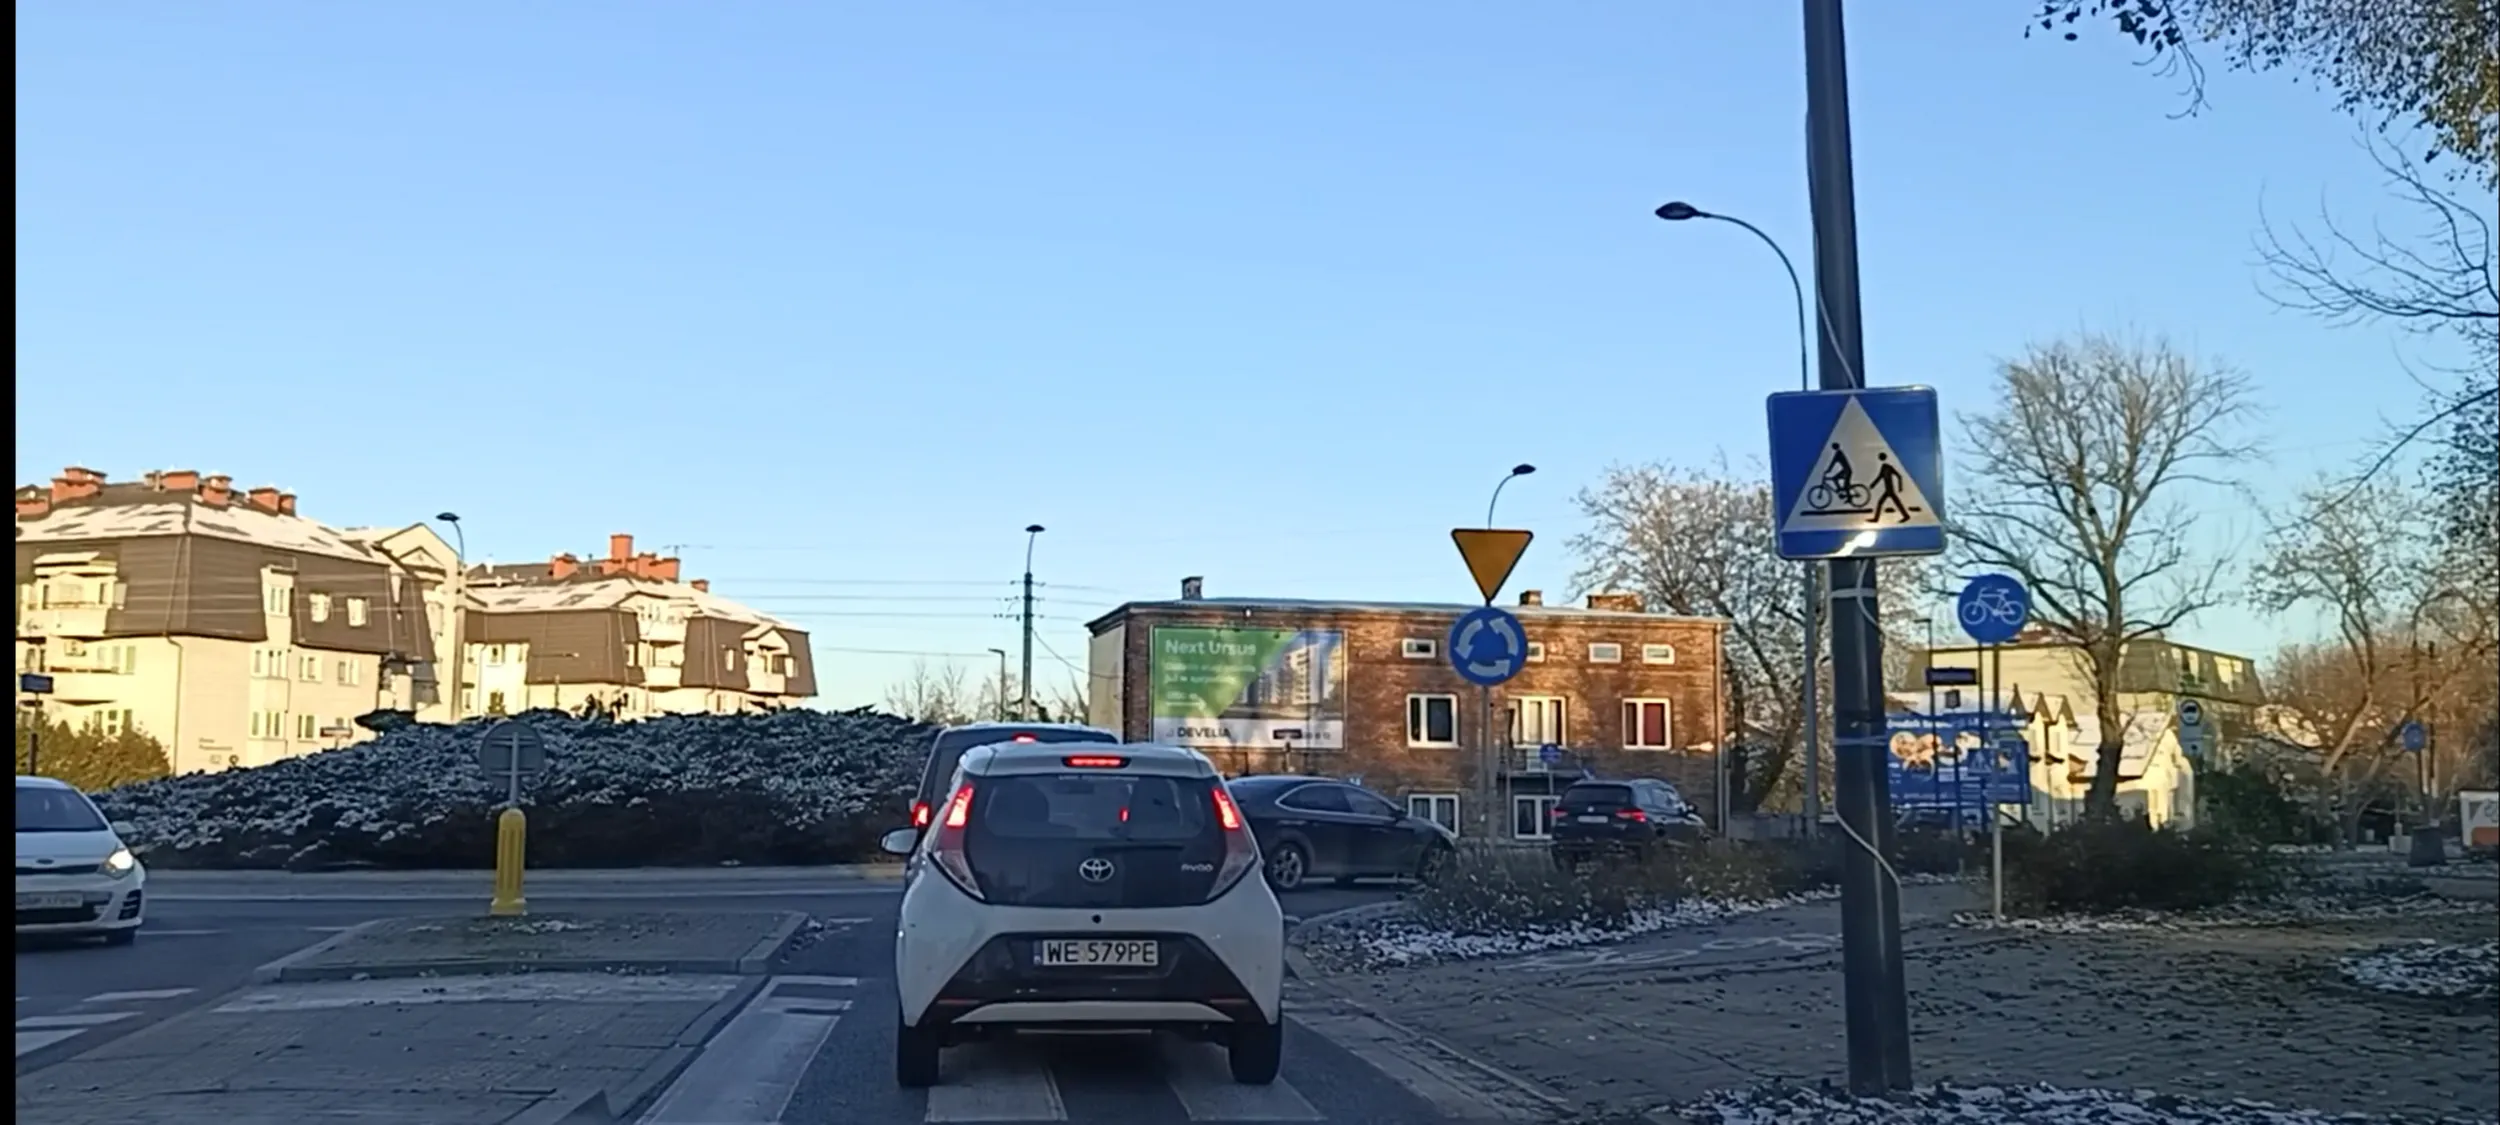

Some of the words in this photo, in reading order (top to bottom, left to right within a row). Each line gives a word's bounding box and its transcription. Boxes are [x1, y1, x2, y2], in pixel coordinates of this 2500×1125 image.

[1165, 640, 1205, 654] Next
[1209, 640, 1256, 656] Ursus
[1177, 727, 1231, 739] DEVELIA
[1047, 943, 1078, 962] WE
[1088, 942, 1155, 962] 579PE
